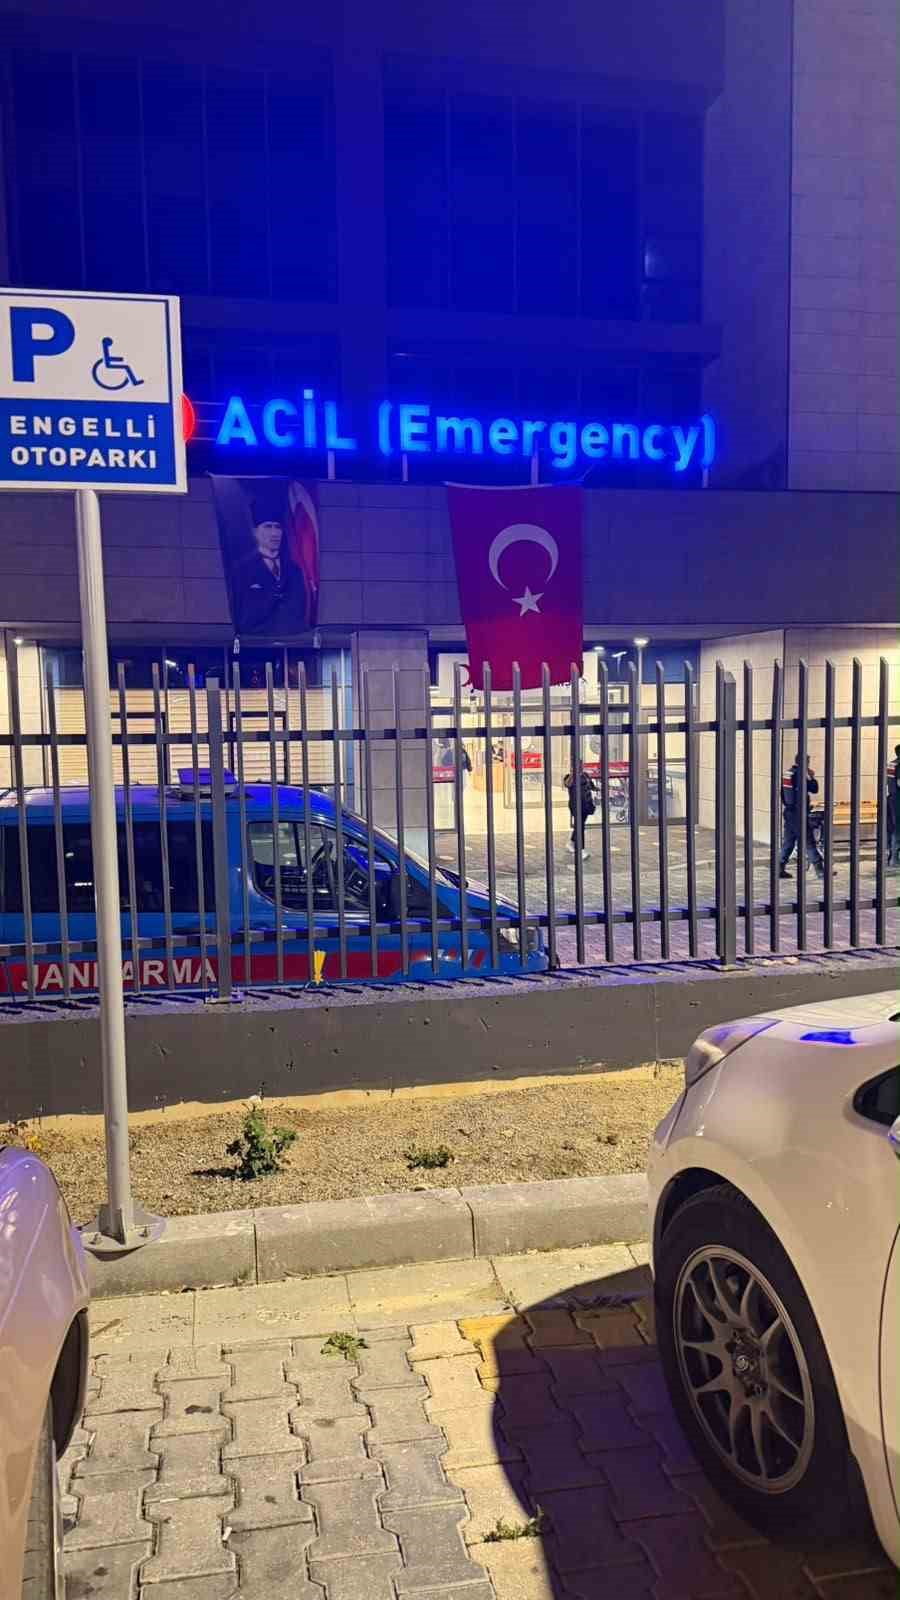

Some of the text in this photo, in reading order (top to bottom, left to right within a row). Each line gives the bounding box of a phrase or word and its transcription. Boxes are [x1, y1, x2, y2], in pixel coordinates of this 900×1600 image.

[10, 306, 75, 382] P
[10, 414, 156, 438] ENGELLİ
[215, 388, 716, 472] ACİL (Emergency)
[11, 446, 157, 469] OTOPARKI
[21, 958, 217, 990] JANARMA
